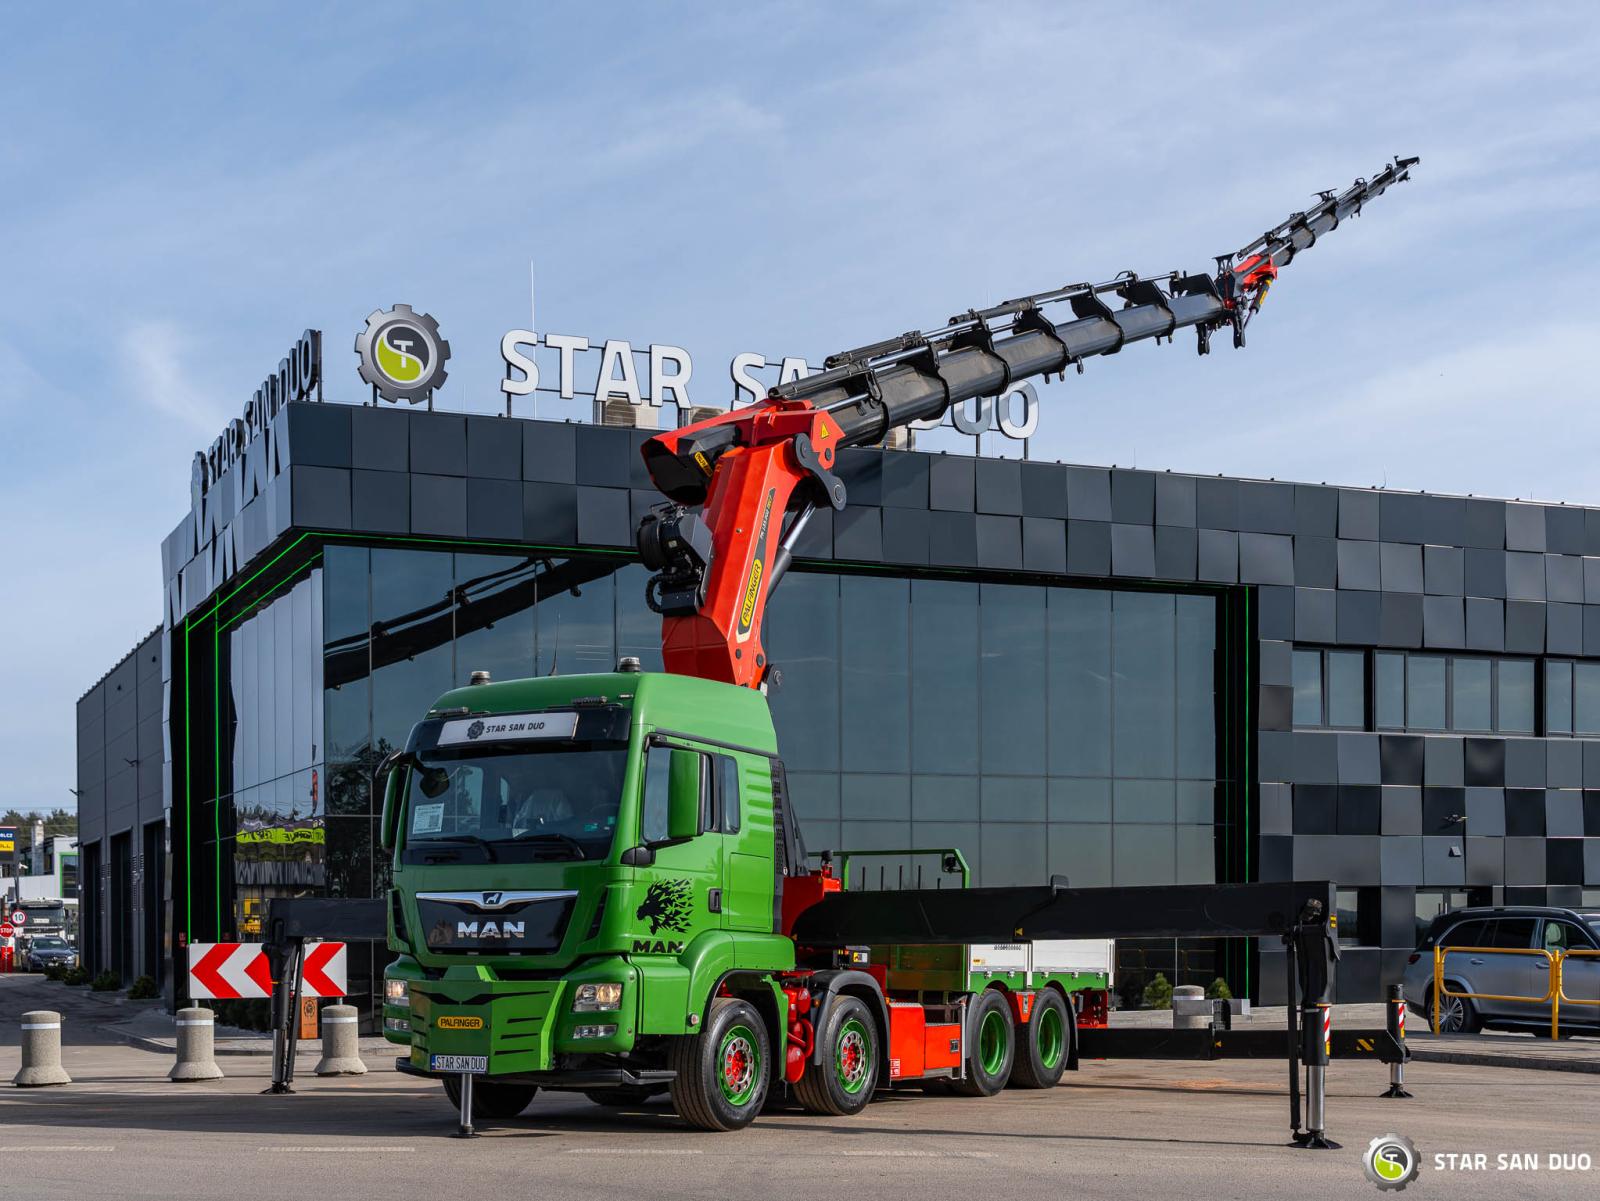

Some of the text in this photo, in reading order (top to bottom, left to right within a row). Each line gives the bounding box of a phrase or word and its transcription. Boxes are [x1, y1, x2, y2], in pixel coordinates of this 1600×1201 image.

[279, 329, 318, 411] DUO
[501, 329, 692, 409] STAR
[743, 563, 761, 623] PALFINGER
[486, 722, 545, 733] STAR SAN DUO
[14, 913, 24, 922] 10
[458, 921, 525, 938] MAN
[632, 940, 684, 954] MAN
[440, 1018, 480, 1028] PALFINGER
[436, 1056, 486, 1070] STAR SAN DUO
